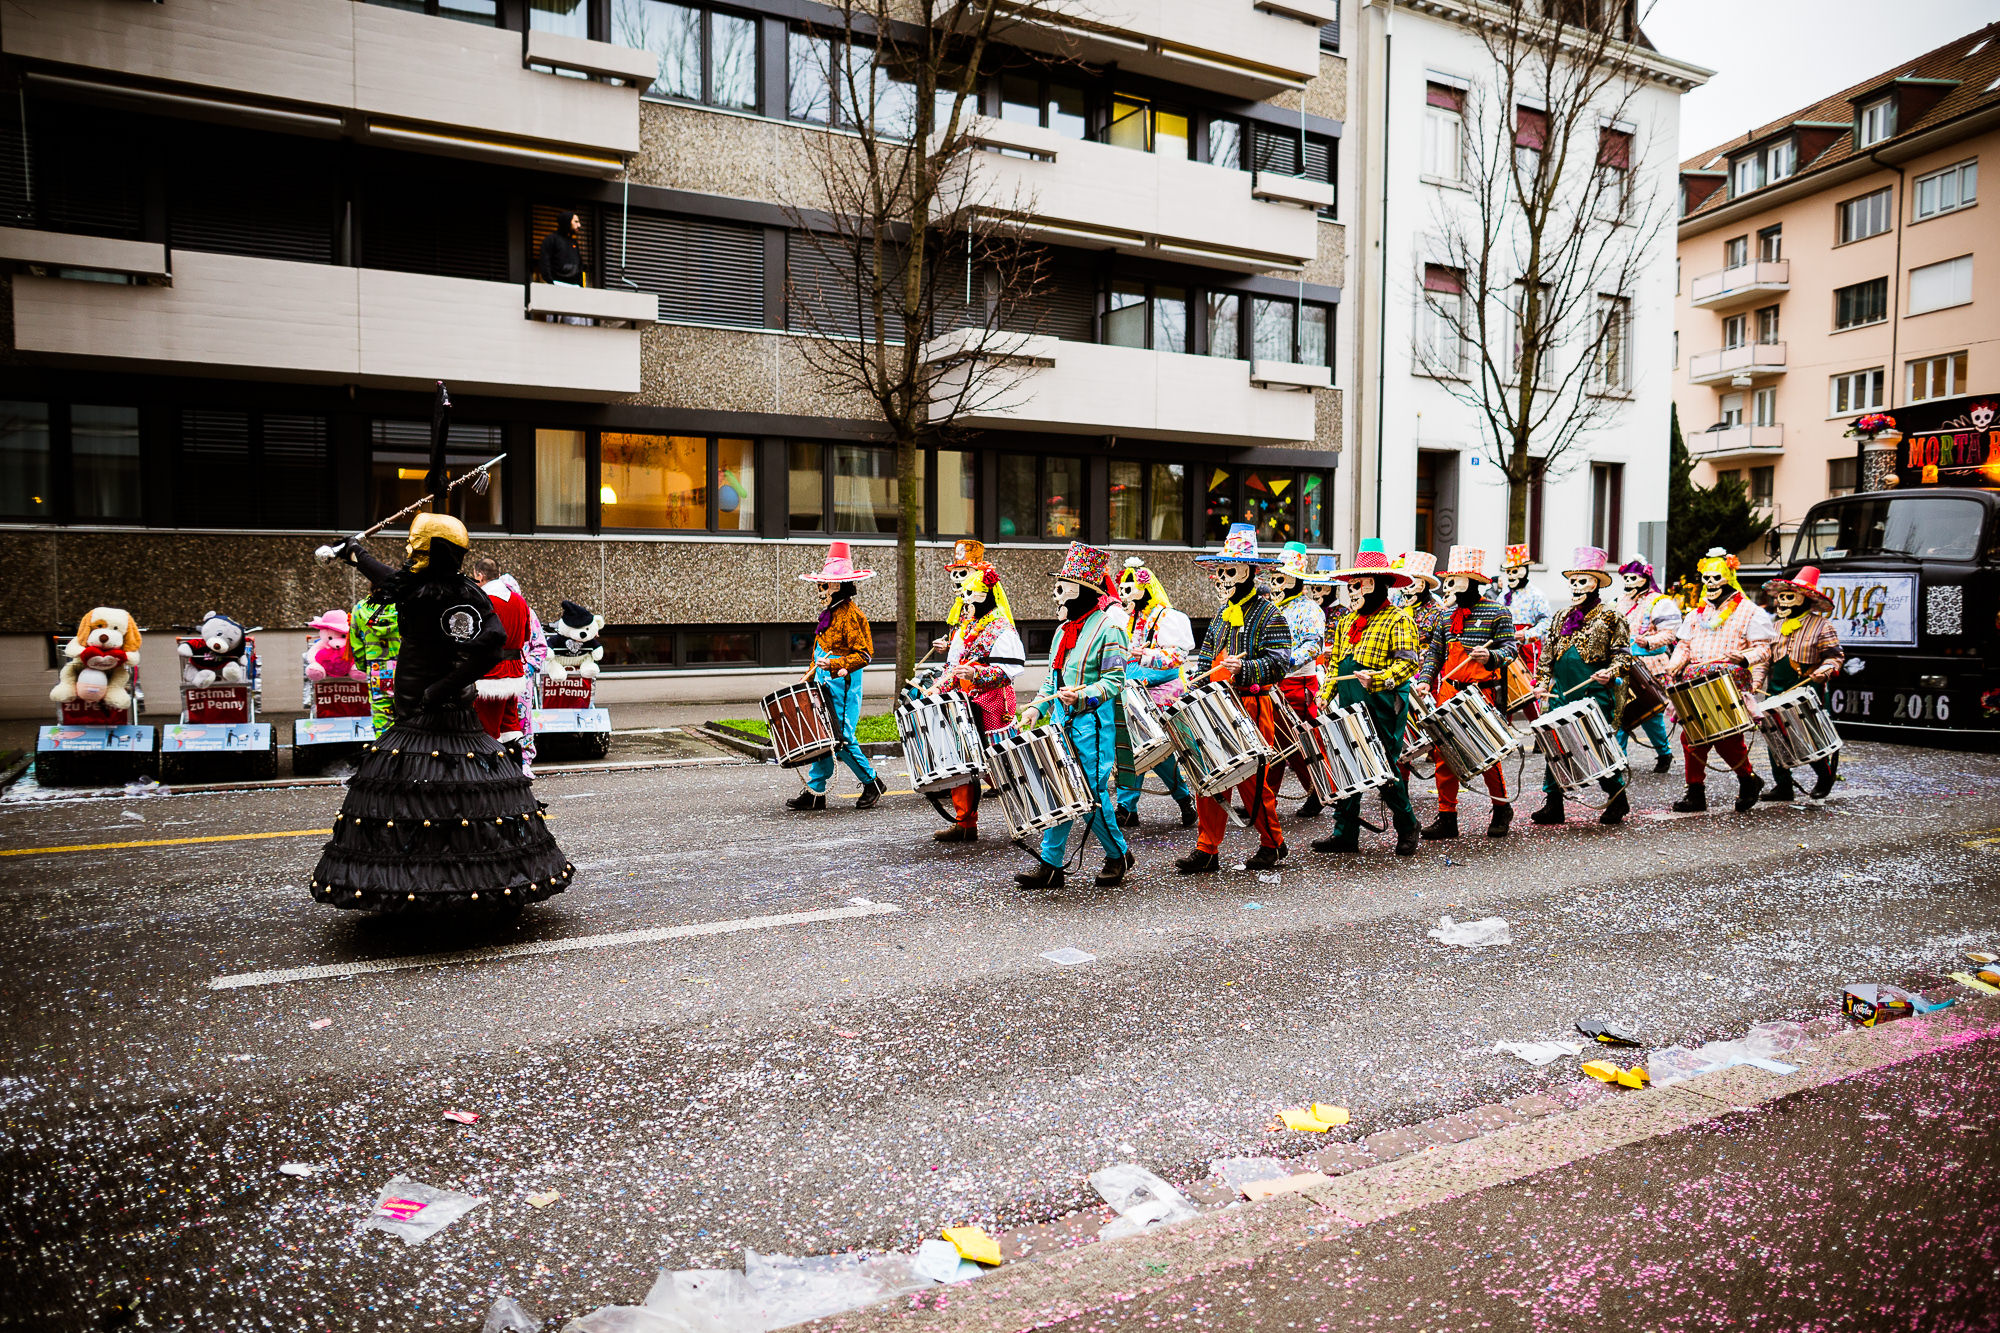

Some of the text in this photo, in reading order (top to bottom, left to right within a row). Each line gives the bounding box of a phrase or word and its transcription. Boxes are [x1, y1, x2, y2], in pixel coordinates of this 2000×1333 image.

[1907, 433, 1981, 468] MORTA
[545, 677, 584, 687] Erstmal
[188, 688, 236, 700] Erstmal
[317, 683, 361, 694] Erstmal
[545, 687, 590, 699] zu Penny
[318, 694, 368, 705] zu Penny
[64, 703, 80, 712] zu
[190, 700, 245, 711] zu Penny
[1893, 694, 1950, 720] 2016
